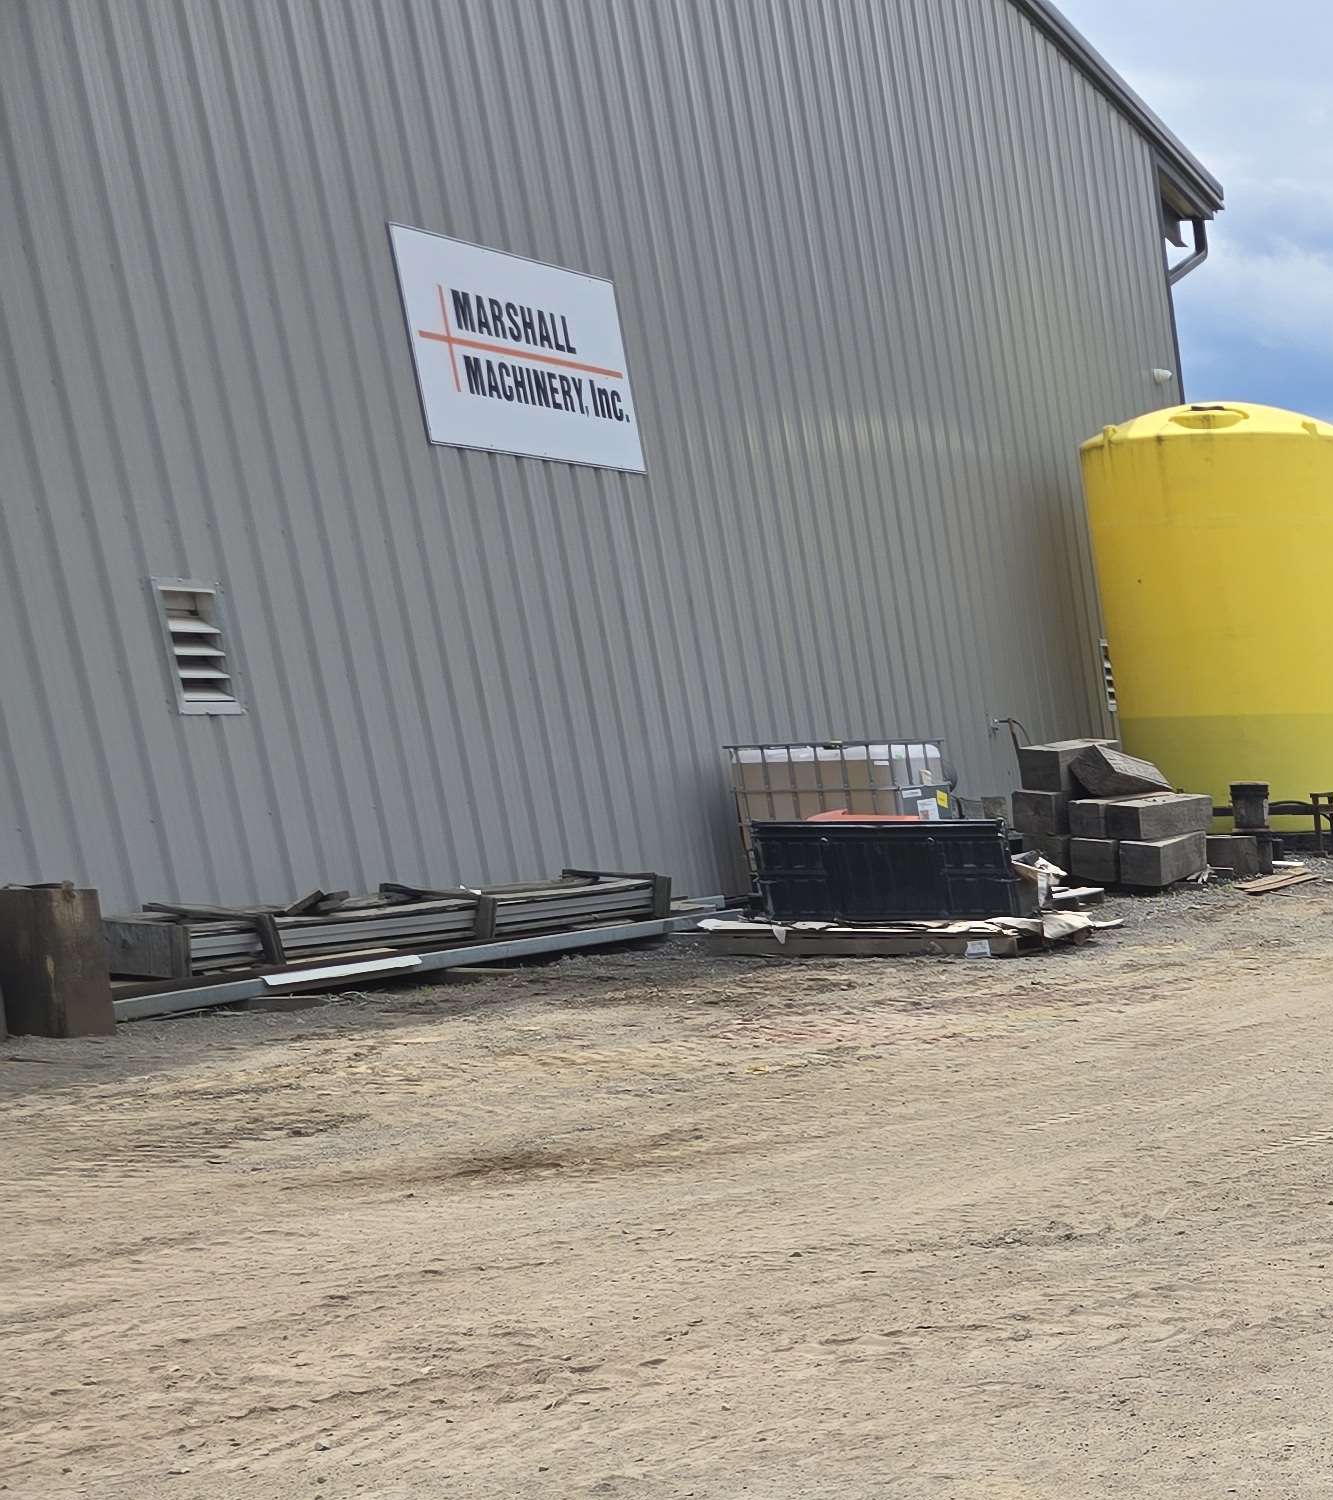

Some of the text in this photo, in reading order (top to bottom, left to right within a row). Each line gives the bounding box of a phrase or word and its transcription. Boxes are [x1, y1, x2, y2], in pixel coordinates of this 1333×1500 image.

[450, 288, 577, 355] MARSHALL
[462, 355, 631, 422] MACHINERY, Inc.
